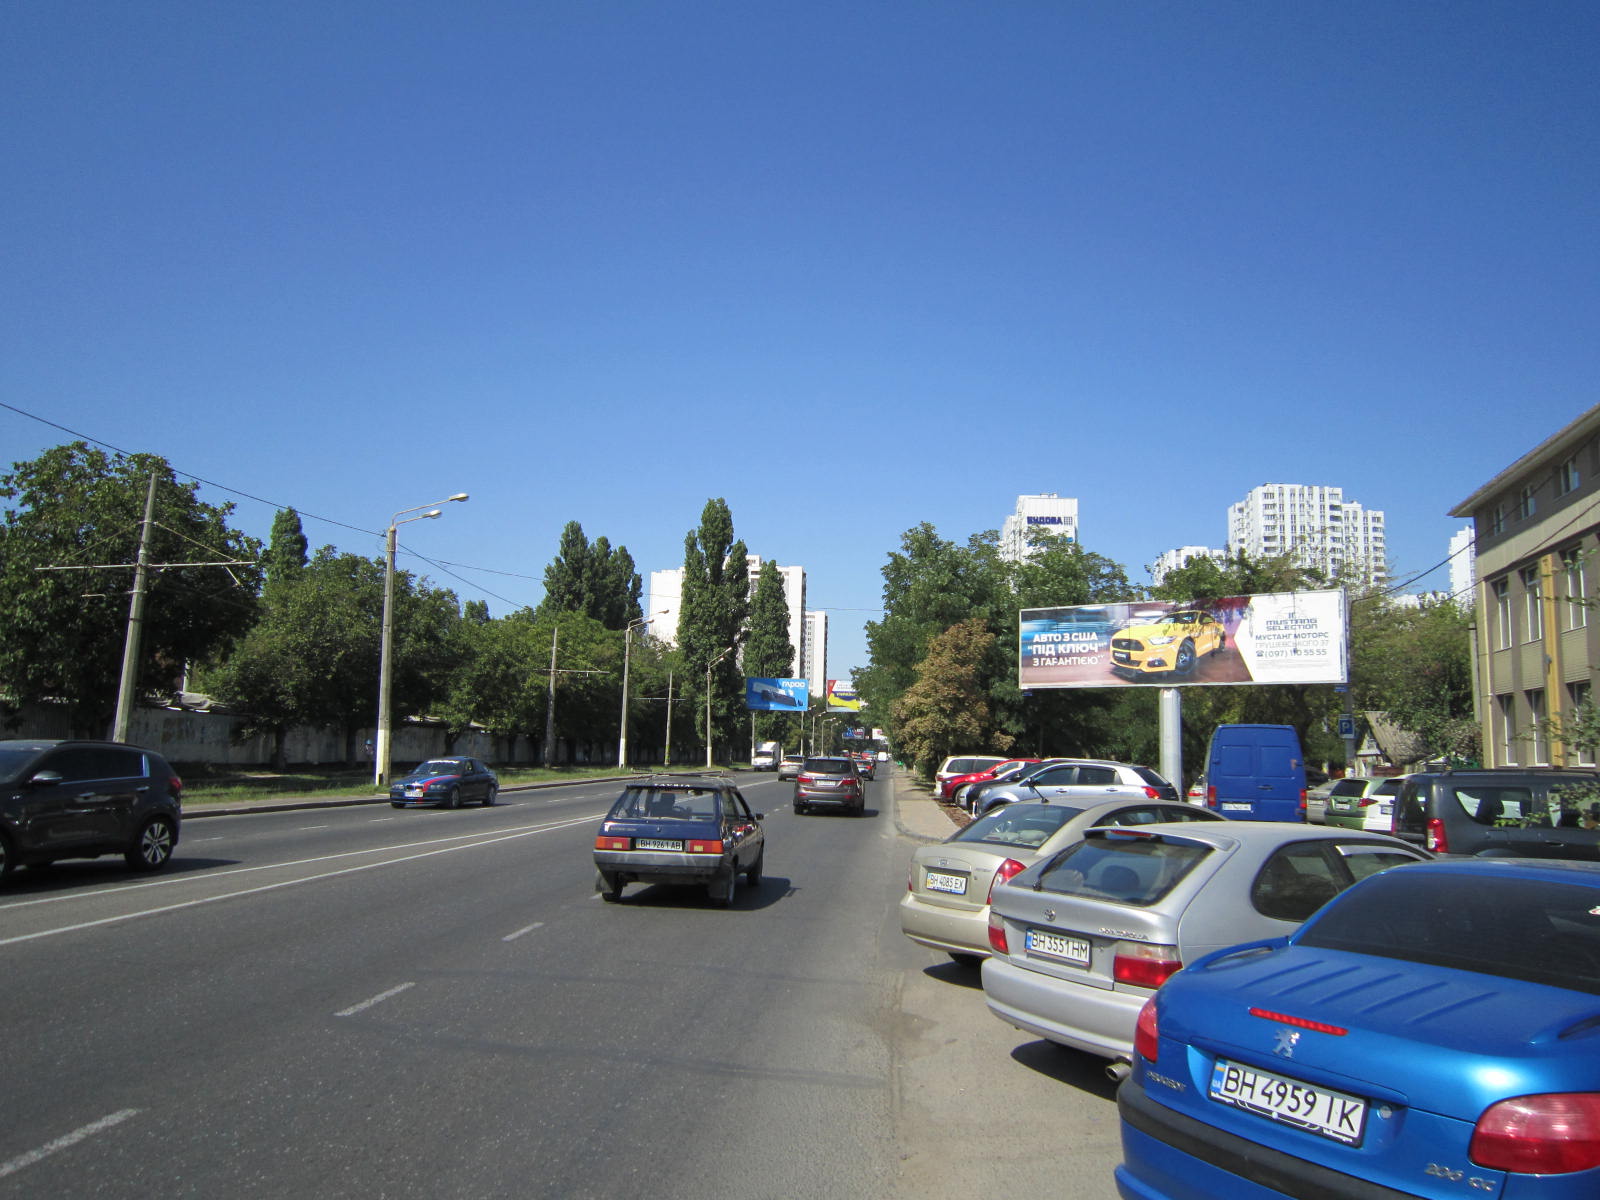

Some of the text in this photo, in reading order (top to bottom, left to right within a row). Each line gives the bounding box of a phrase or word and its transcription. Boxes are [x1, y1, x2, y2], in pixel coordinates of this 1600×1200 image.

[1266, 623, 1318, 631] SELECTION
[1033, 632, 1098, 642] АВТО З США
[1265, 650, 1288, 658] (097)
[1033, 658, 1039, 666] З
[652, 840, 669, 848] 9261
[1031, 932, 1088, 960] BH 3551 HM
[1223, 1067, 1257, 1100] BH
[1261, 1078, 1317, 1117] 4959
[1326, 1095, 1360, 1133] IK
[1424, 1162, 1497, 1192] 206 CC
